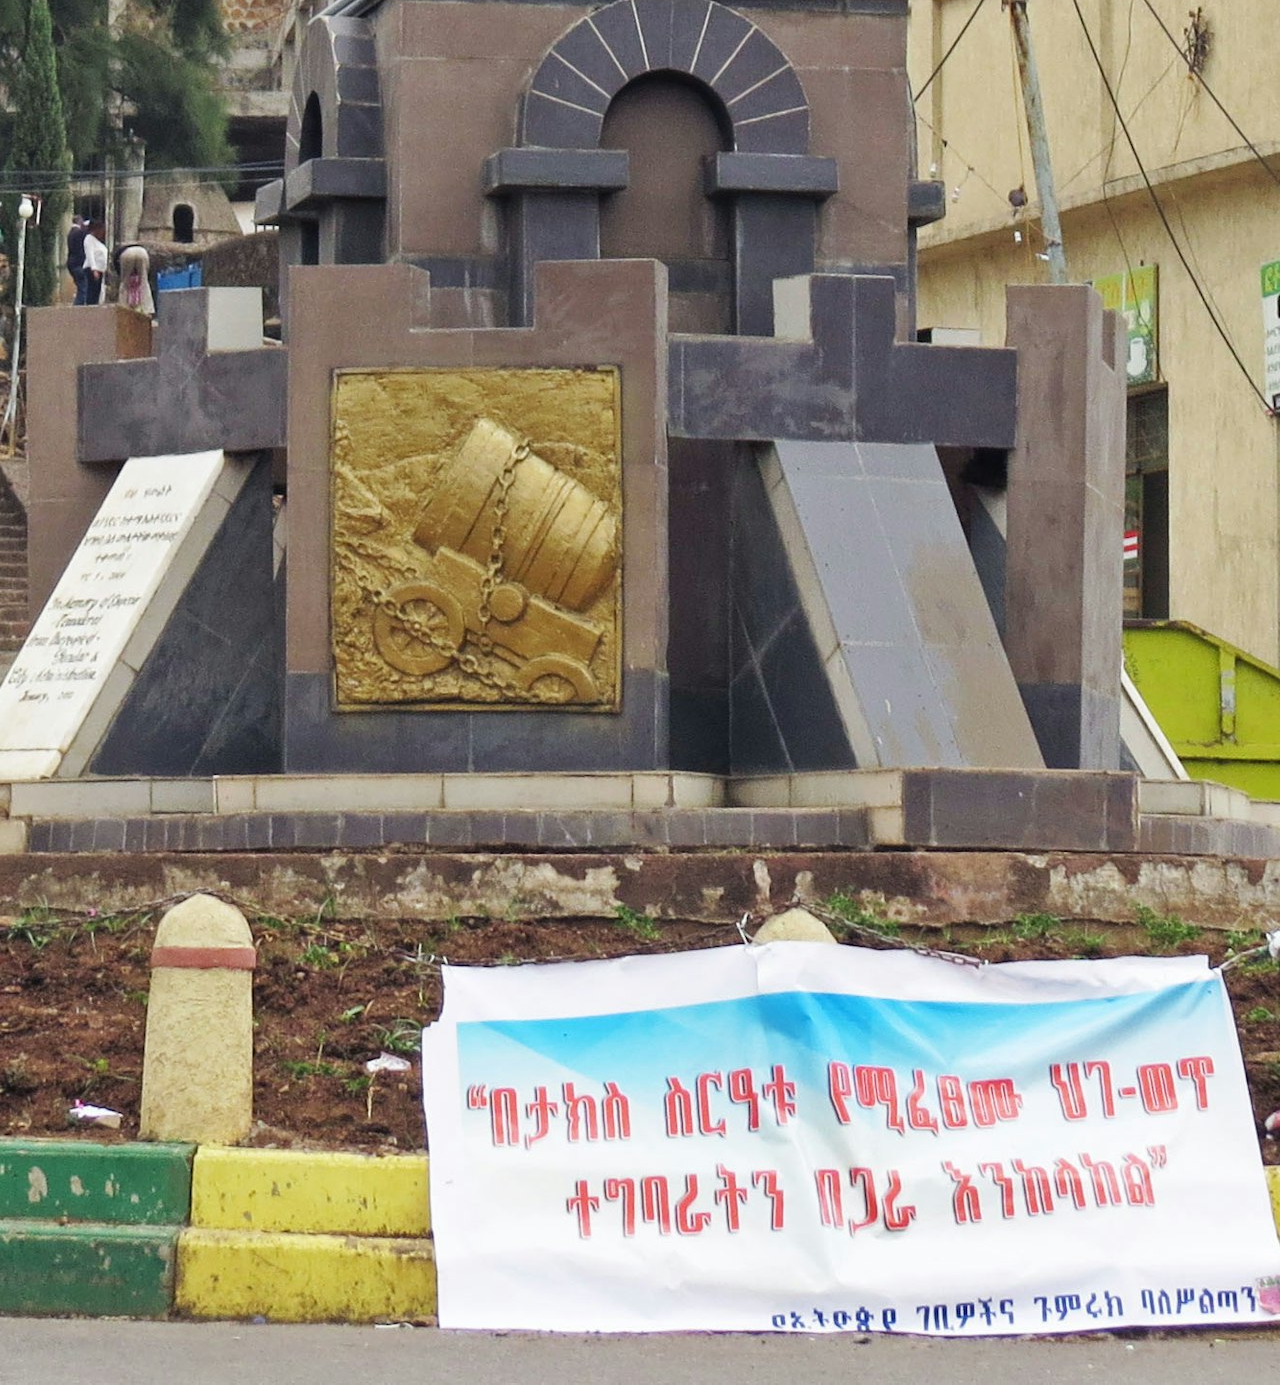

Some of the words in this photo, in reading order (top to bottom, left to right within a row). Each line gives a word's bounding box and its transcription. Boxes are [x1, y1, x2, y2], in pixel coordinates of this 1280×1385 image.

[467, 1082, 631, 1149] “በታክስ
[665, 1064, 797, 1138] ስርዓቱ
[826, 1060, 1023, 1136] የሚፈፀሙ
[1050, 1055, 1216, 1121] ህገ-ወጥ
[567, 1163, 786, 1239] ተግባራትን
[814, 1166, 917, 1236] በጋራ
[1033, 1290, 1124, 1322] ጉምሩክ
[1141, 1286, 1257, 1316] ባለሥልጣን
